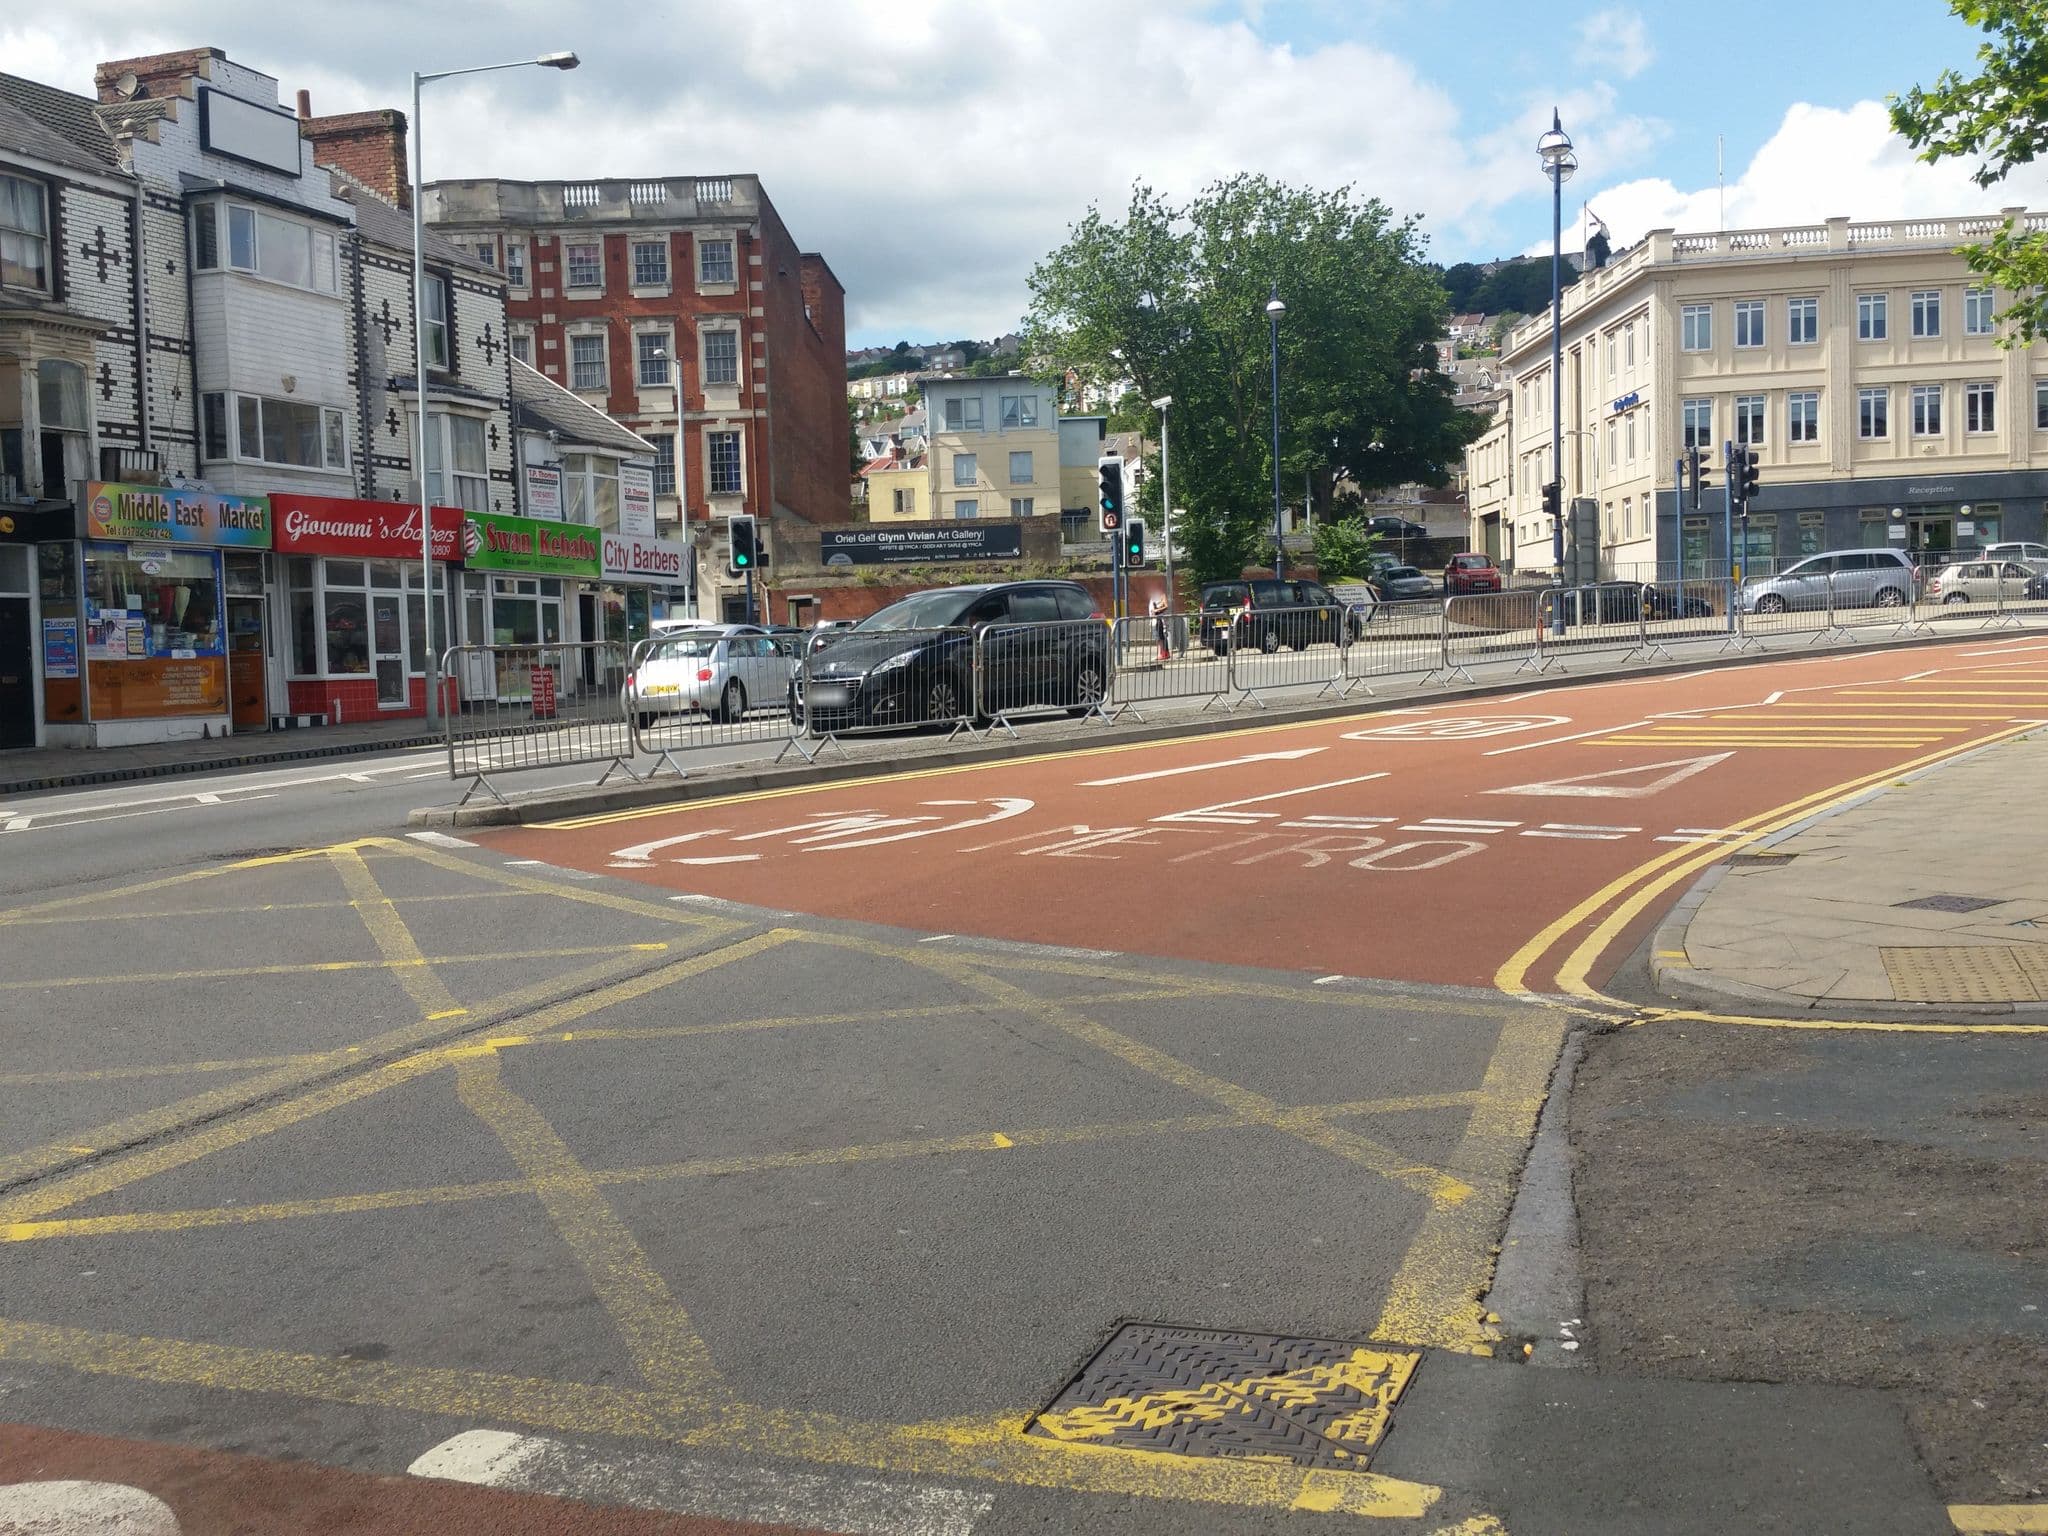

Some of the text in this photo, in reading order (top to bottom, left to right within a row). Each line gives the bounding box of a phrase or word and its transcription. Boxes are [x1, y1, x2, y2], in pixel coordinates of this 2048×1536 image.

[1908, 485, 1955, 495] Reception
[118, 493, 168, 523] Middle
[175, 500, 204, 527] East
[219, 503, 265, 530] Market
[486, 521, 597, 561] Swan Kebabs
[835, 530, 982, 544] Oriel Gelf Glynn Vivian Art Gallery
[604, 539, 680, 573] City Barbers
